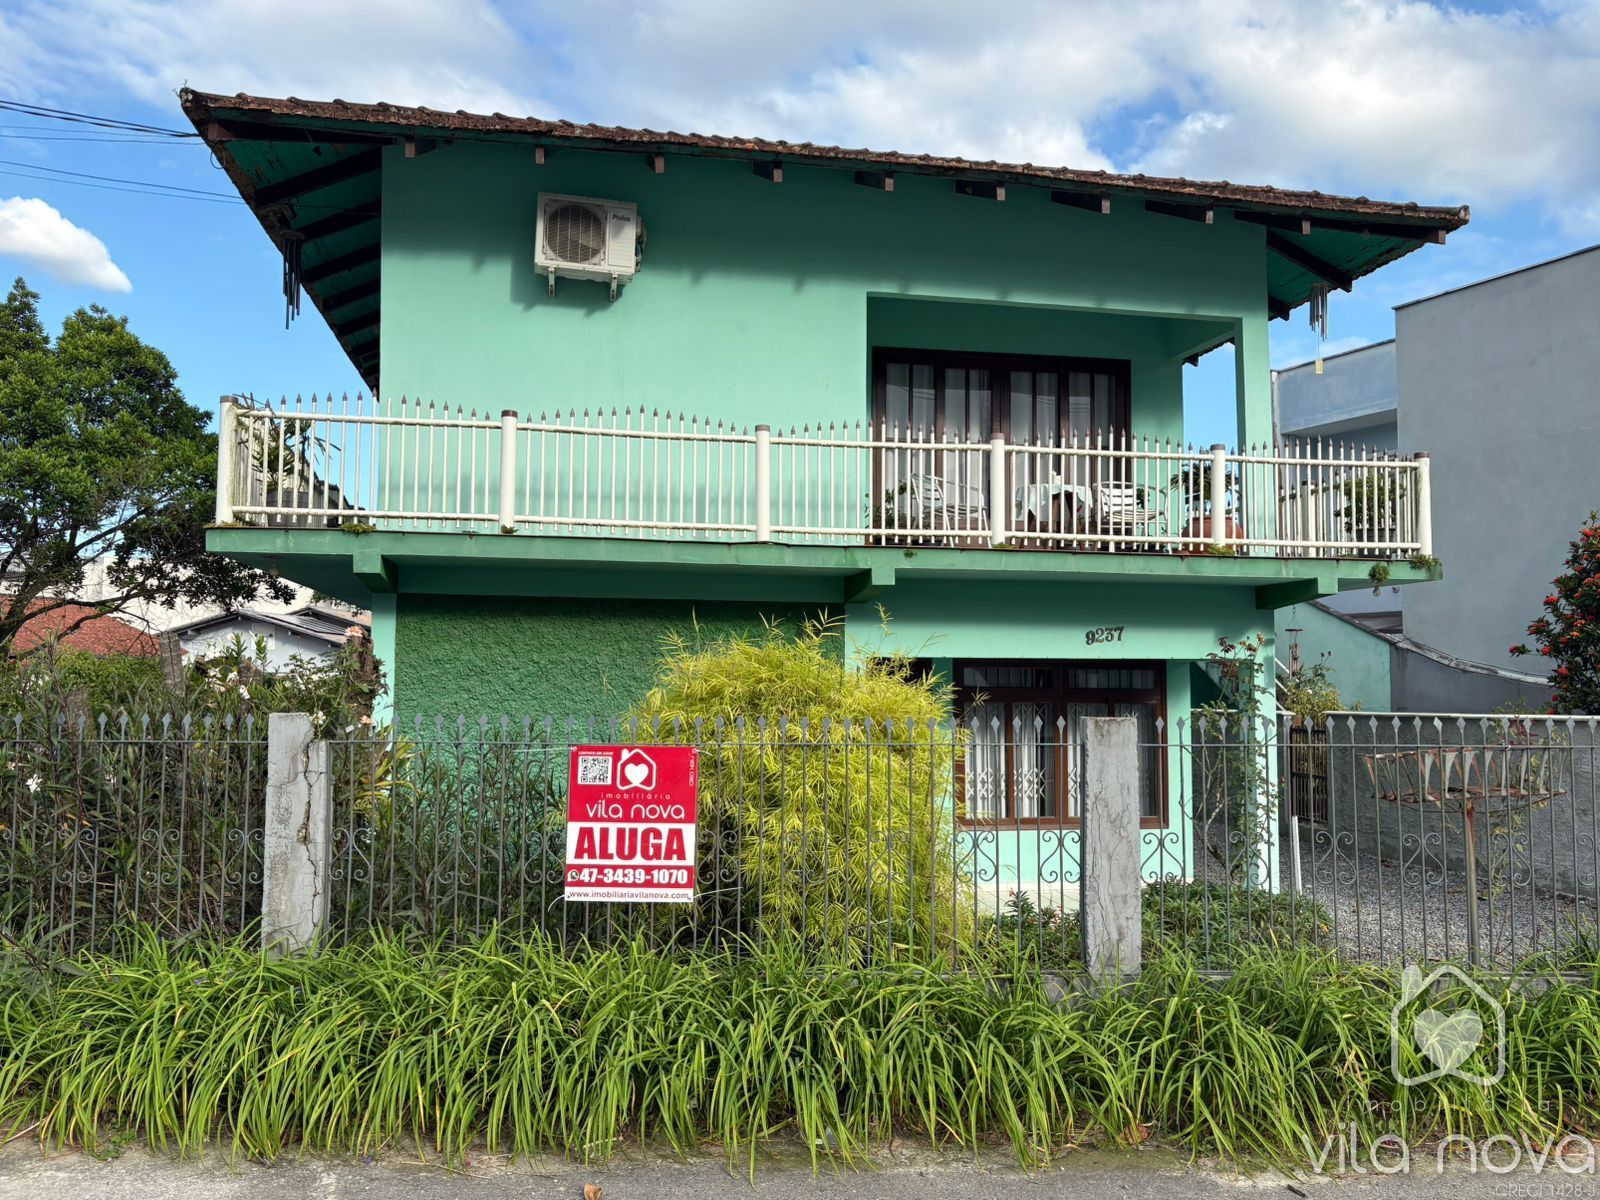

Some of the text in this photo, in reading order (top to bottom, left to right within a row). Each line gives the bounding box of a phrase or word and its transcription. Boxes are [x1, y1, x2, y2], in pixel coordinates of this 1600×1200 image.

[612, 214, 631, 222] Philco
[1085, 626, 1125, 645] 9237
[586, 800, 685, 819] vila nova
[574, 827, 687, 861] ALUGA
[579, 868, 688, 884] 47-3439-1070
[569, 890, 689, 899] www.imobiliariavilanova.com
